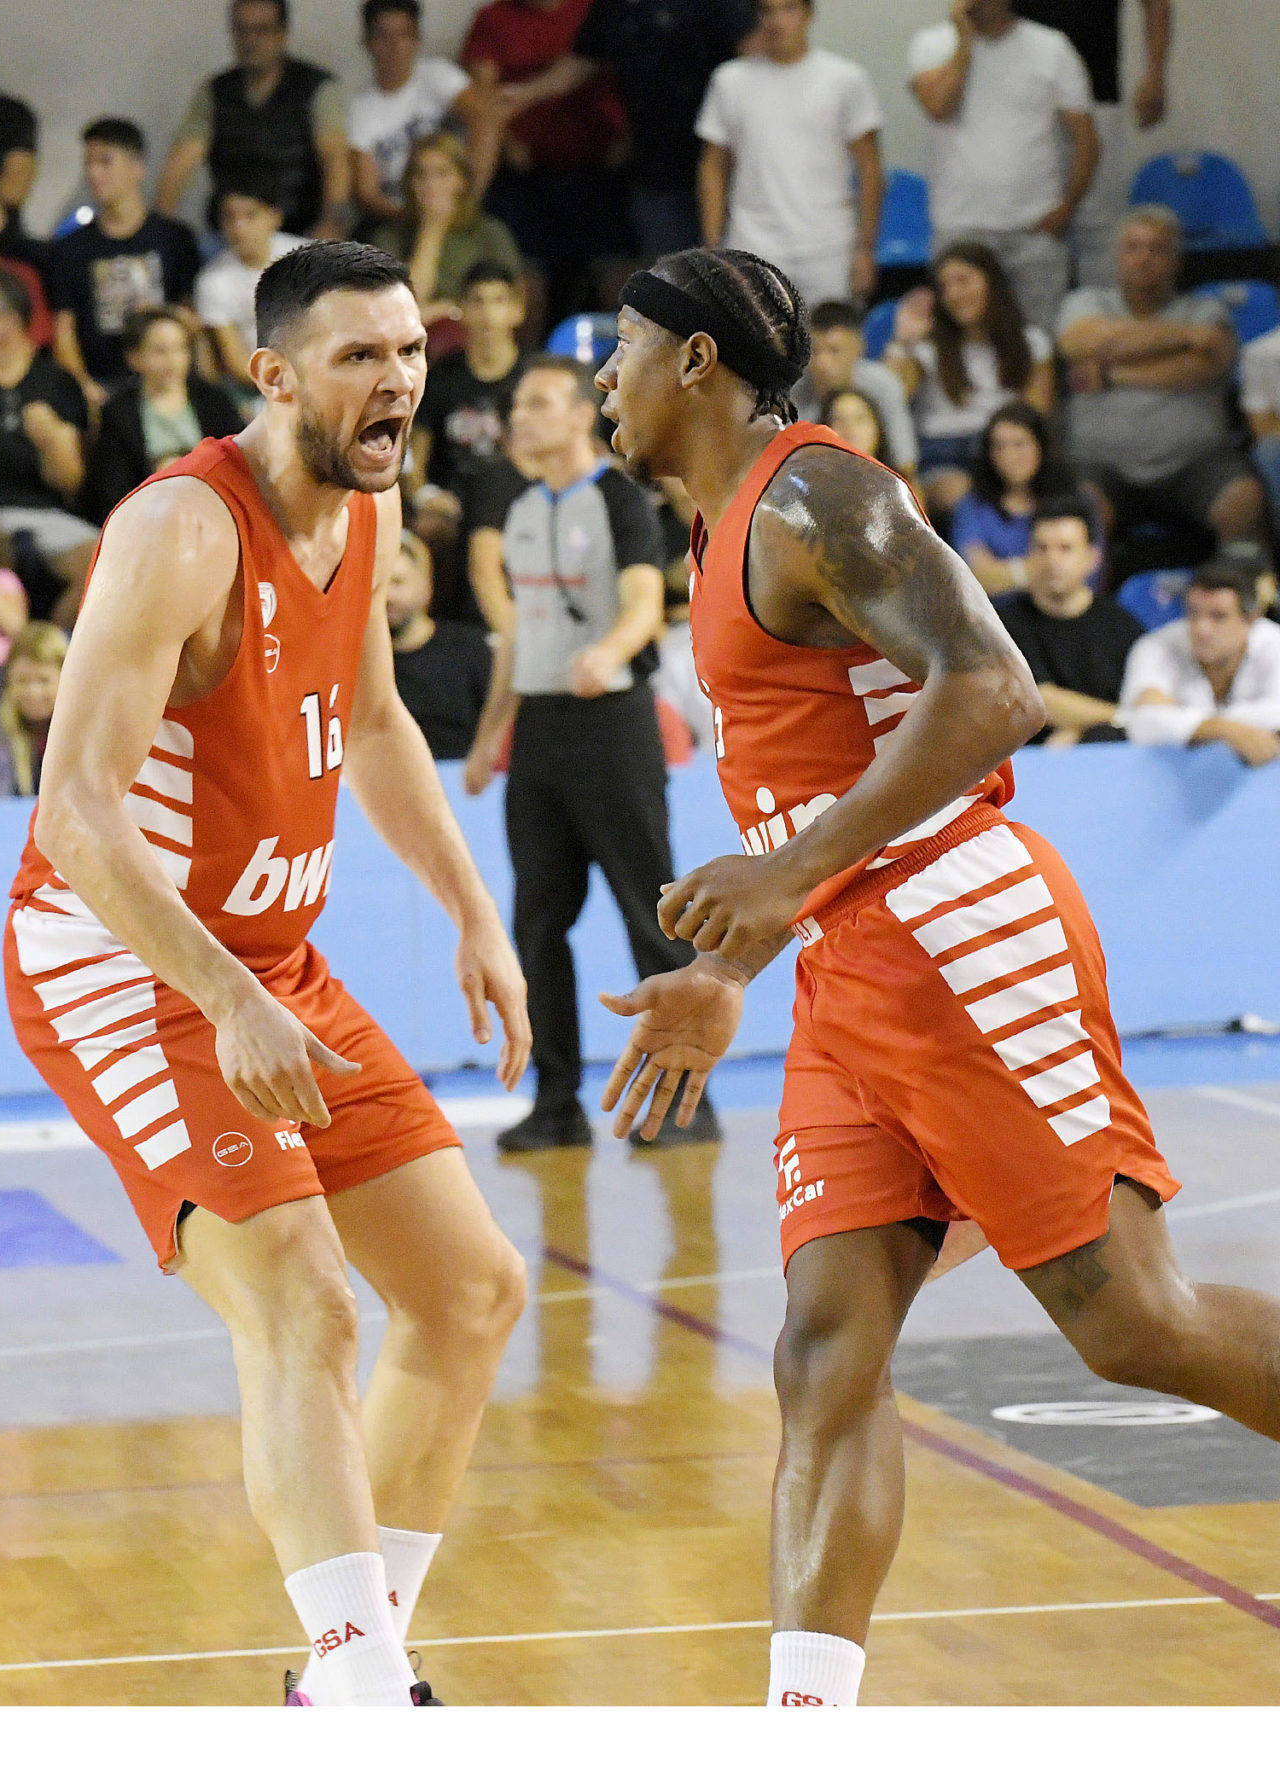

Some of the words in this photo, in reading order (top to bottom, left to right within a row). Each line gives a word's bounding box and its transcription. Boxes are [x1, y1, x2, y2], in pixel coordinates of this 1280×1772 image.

[300, 683, 344, 781] 16
[740, 786, 839, 857] win
[221, 835, 335, 916] bw
[313, 1621, 366, 1659] GSA
